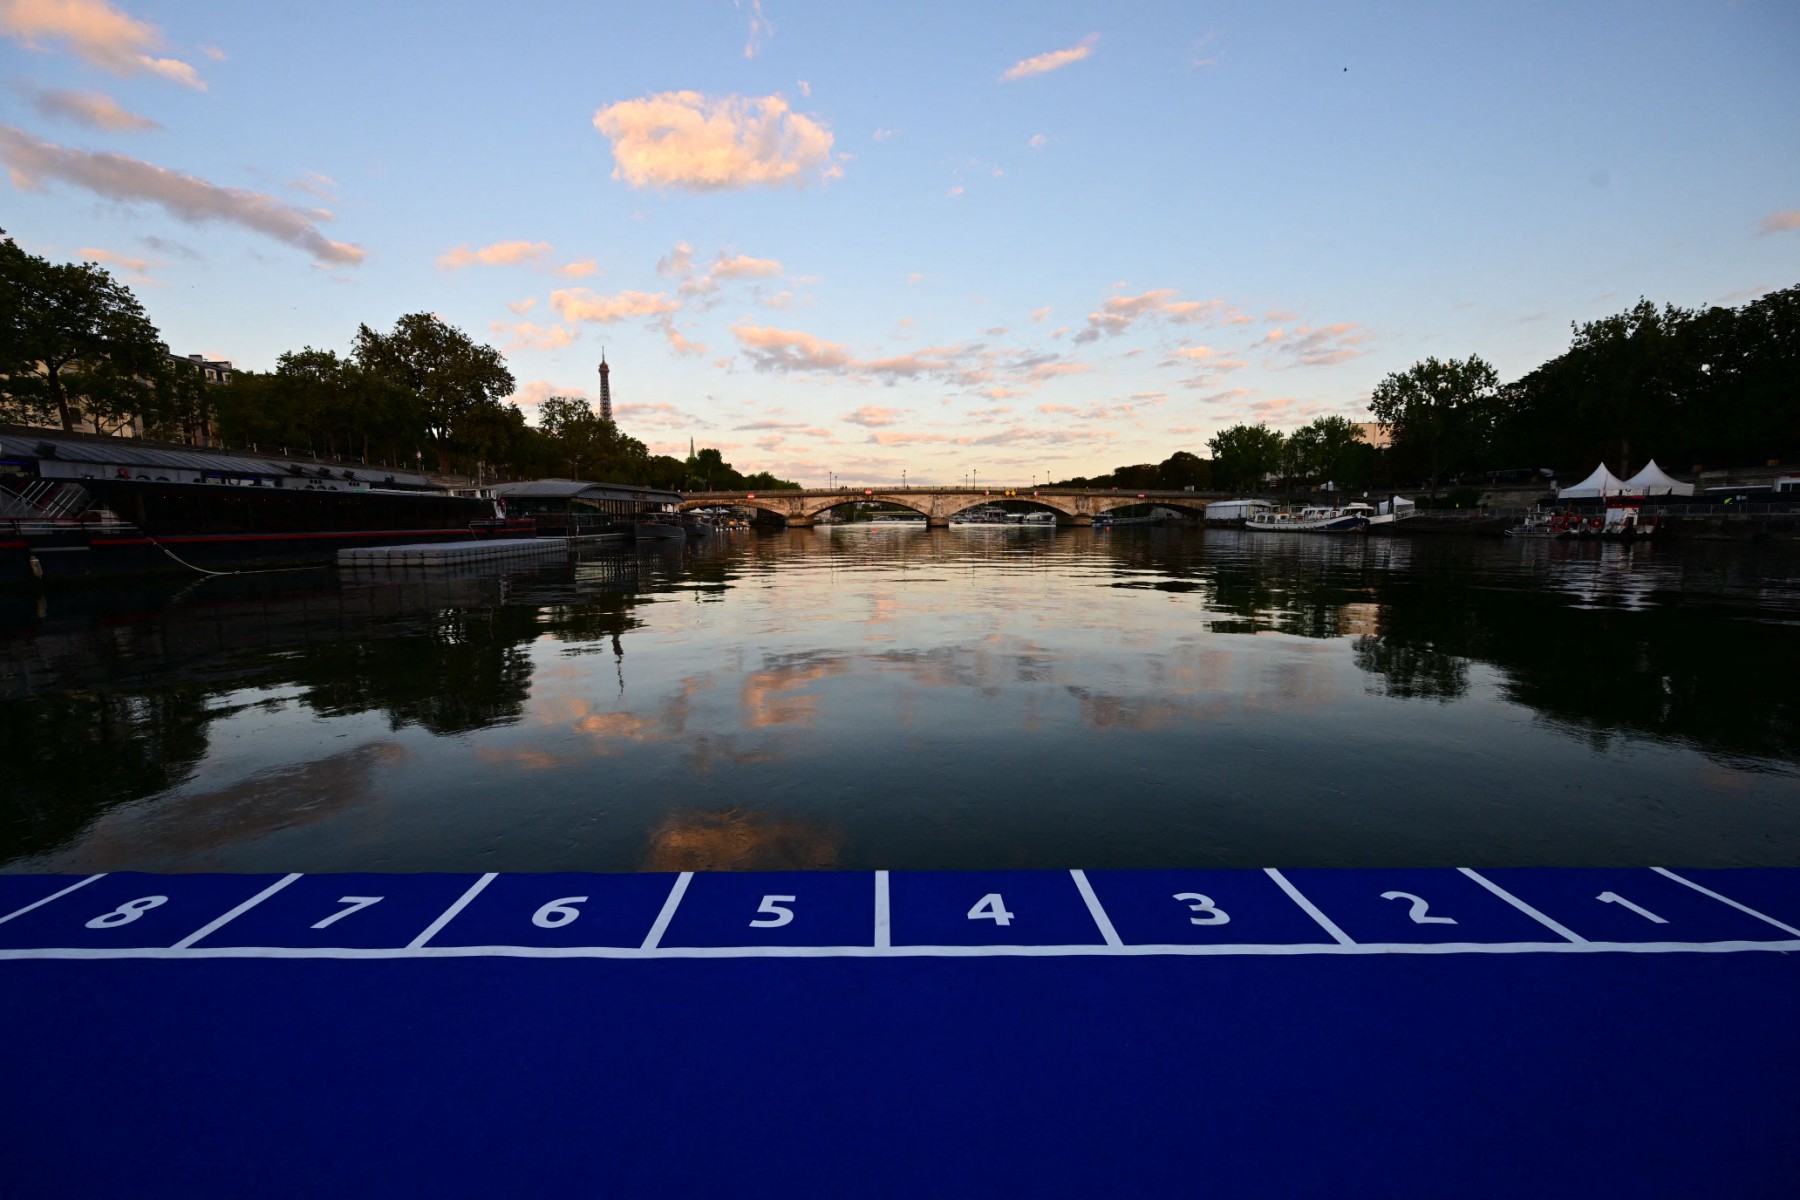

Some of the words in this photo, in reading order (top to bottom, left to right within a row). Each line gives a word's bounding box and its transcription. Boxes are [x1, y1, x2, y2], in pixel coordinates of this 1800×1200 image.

[85, 895, 168, 929] 8
[310, 896, 384, 929] 7
[531, 896, 588, 929] 6
[749, 895, 796, 928] 5
[967, 893, 1015, 926] 4
[1172, 892, 1230, 925] 3
[1380, 891, 1457, 924] 2
[1596, 891, 1668, 923] 1
